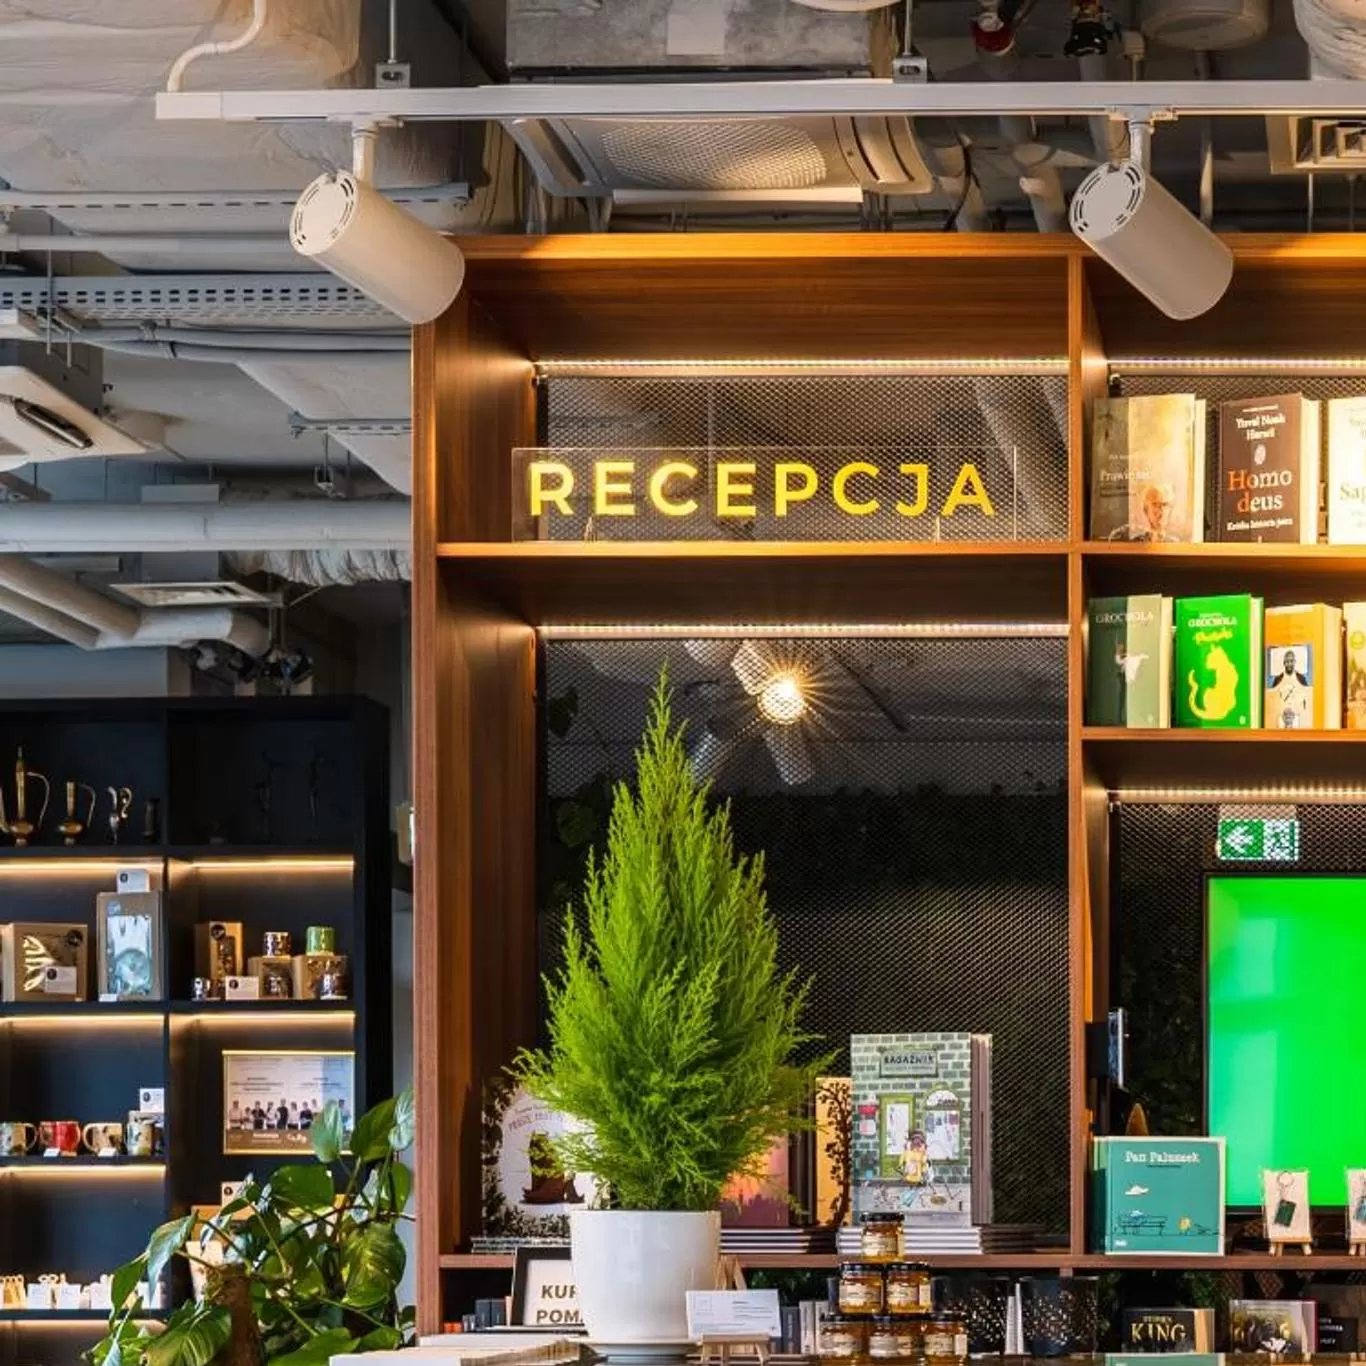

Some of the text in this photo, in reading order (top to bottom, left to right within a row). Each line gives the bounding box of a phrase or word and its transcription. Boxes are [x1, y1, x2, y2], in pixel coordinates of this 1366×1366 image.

[529, 461, 996, 518] RECEPCJA
[1227, 469, 1292, 491] Homo
[1237, 491, 1283, 513] deus
[1125, 1150, 1147, 1163] Pan
[536, 1309, 584, 1325] POM
[1131, 1323, 1186, 1344] KING
